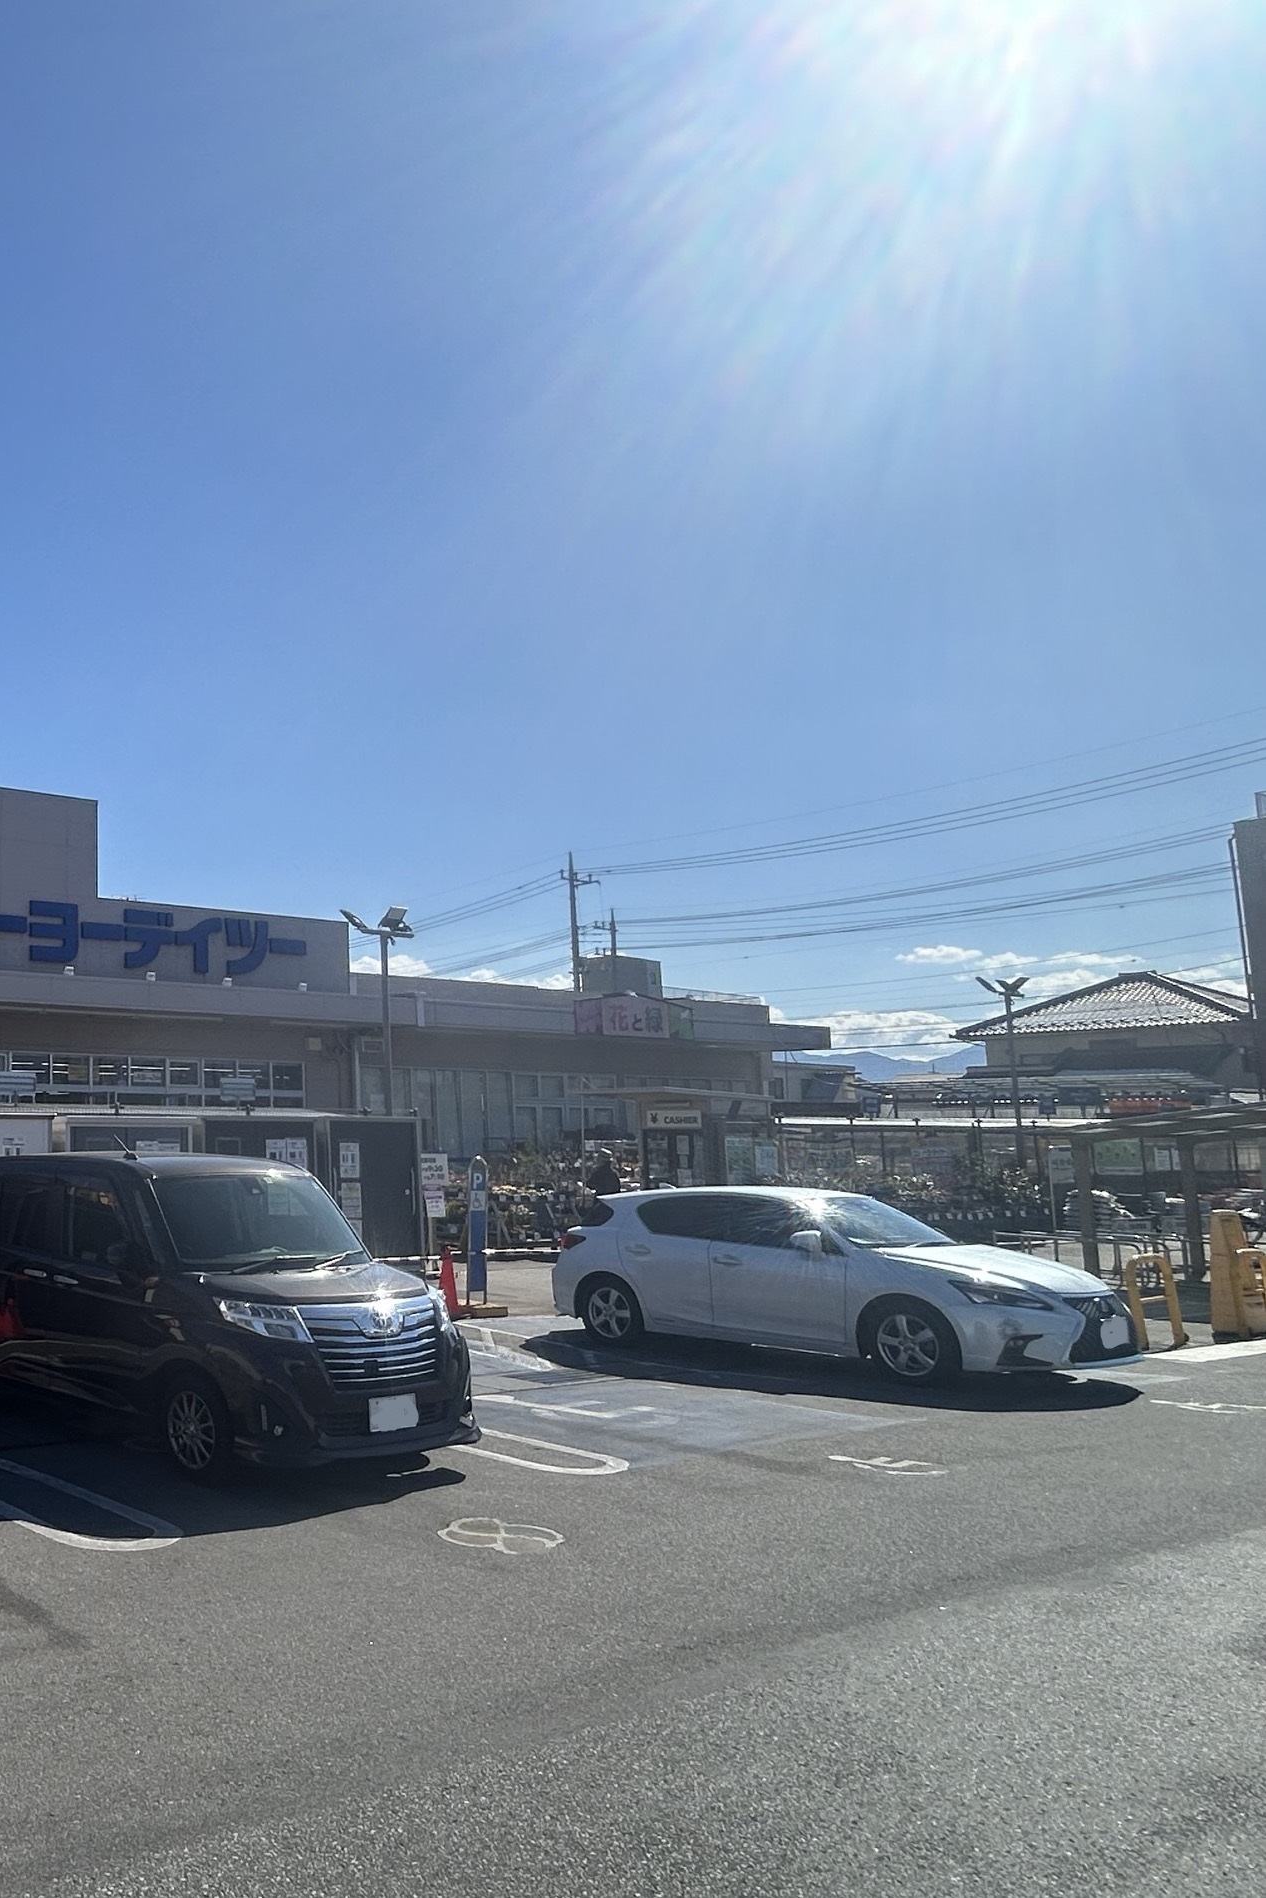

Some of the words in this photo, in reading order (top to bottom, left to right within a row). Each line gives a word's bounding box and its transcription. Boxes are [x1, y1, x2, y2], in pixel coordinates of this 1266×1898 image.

[611, 1004, 663, 1033] 花と緑
[664, 1116, 699, 1125] CASHIER
[473, 1173, 483, 1189] P
